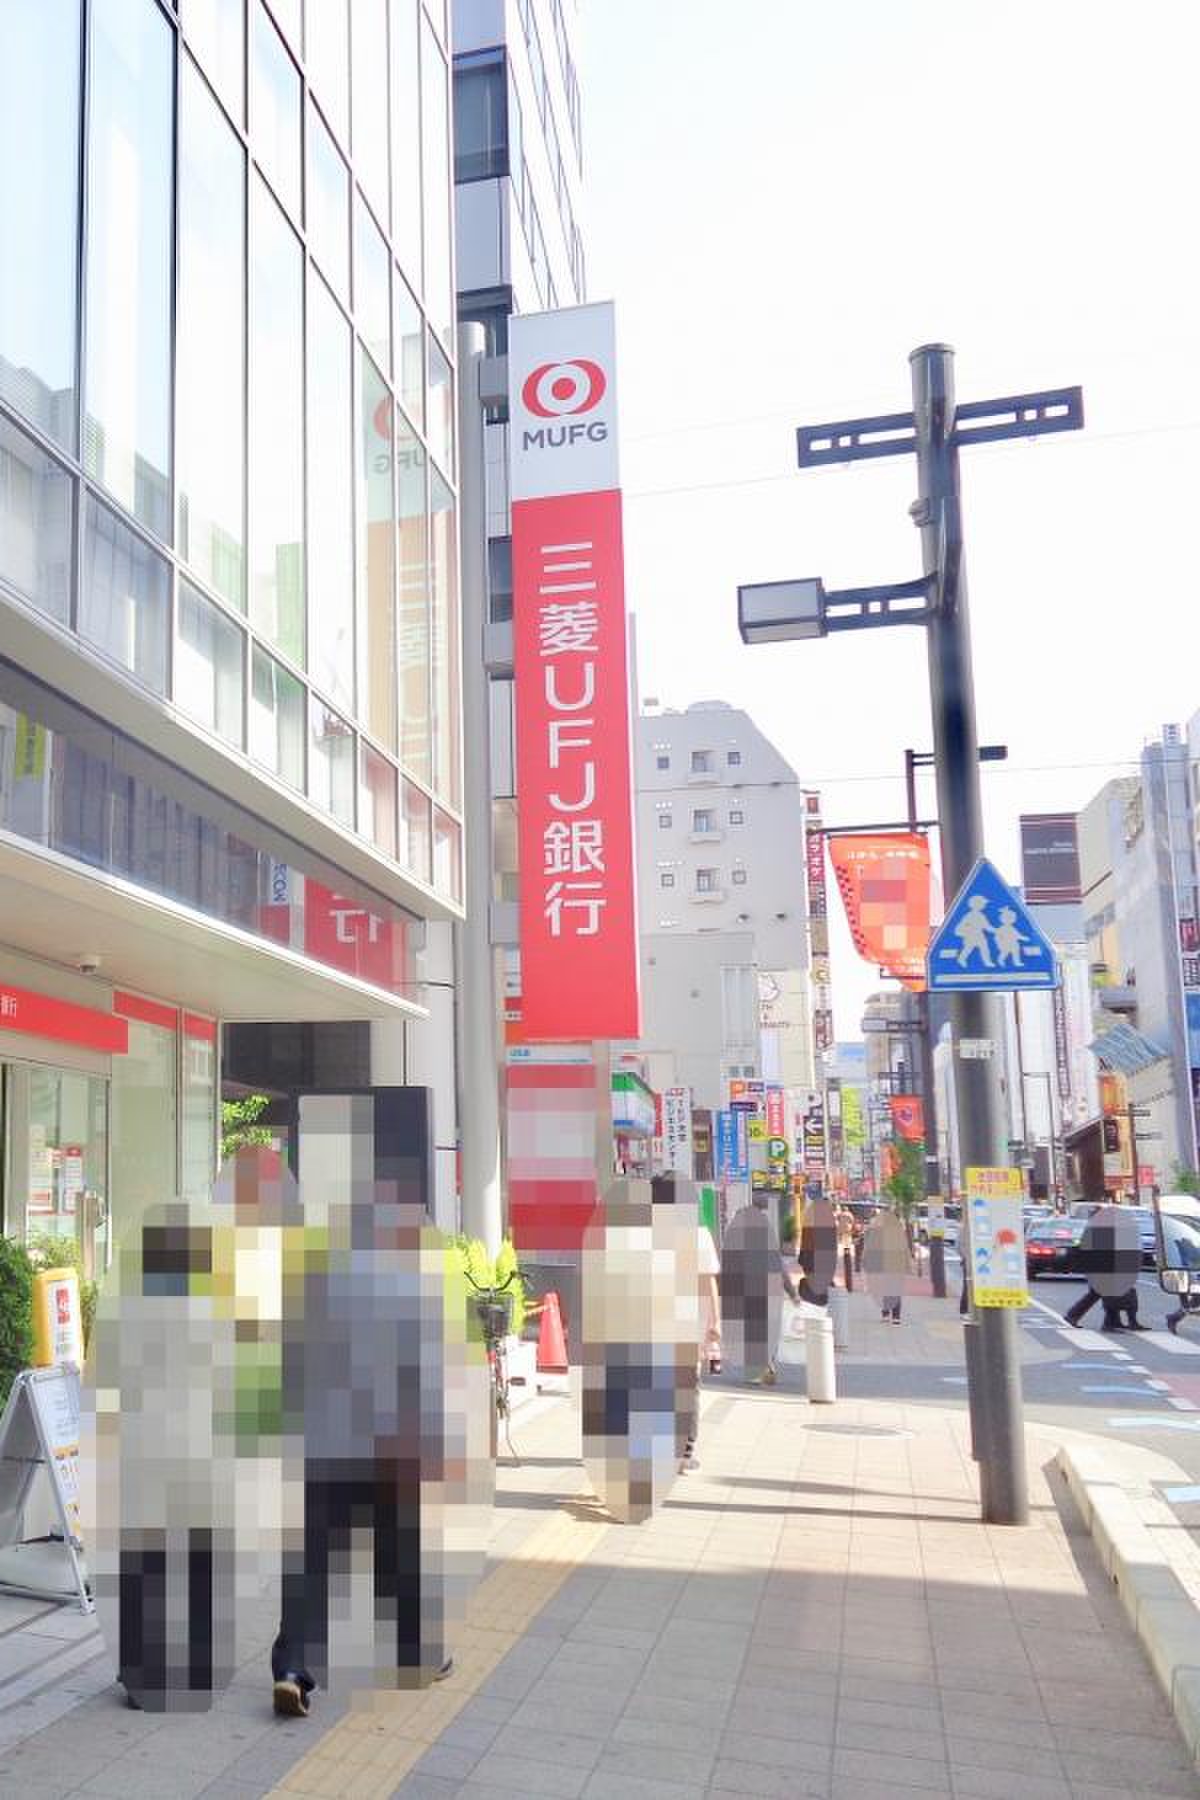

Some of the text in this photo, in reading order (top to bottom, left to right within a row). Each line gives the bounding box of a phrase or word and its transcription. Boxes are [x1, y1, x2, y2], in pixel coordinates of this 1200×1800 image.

[522, 421, 608, 451] MUFG
[538, 541, 607, 937] 三菱UFJ銀行
